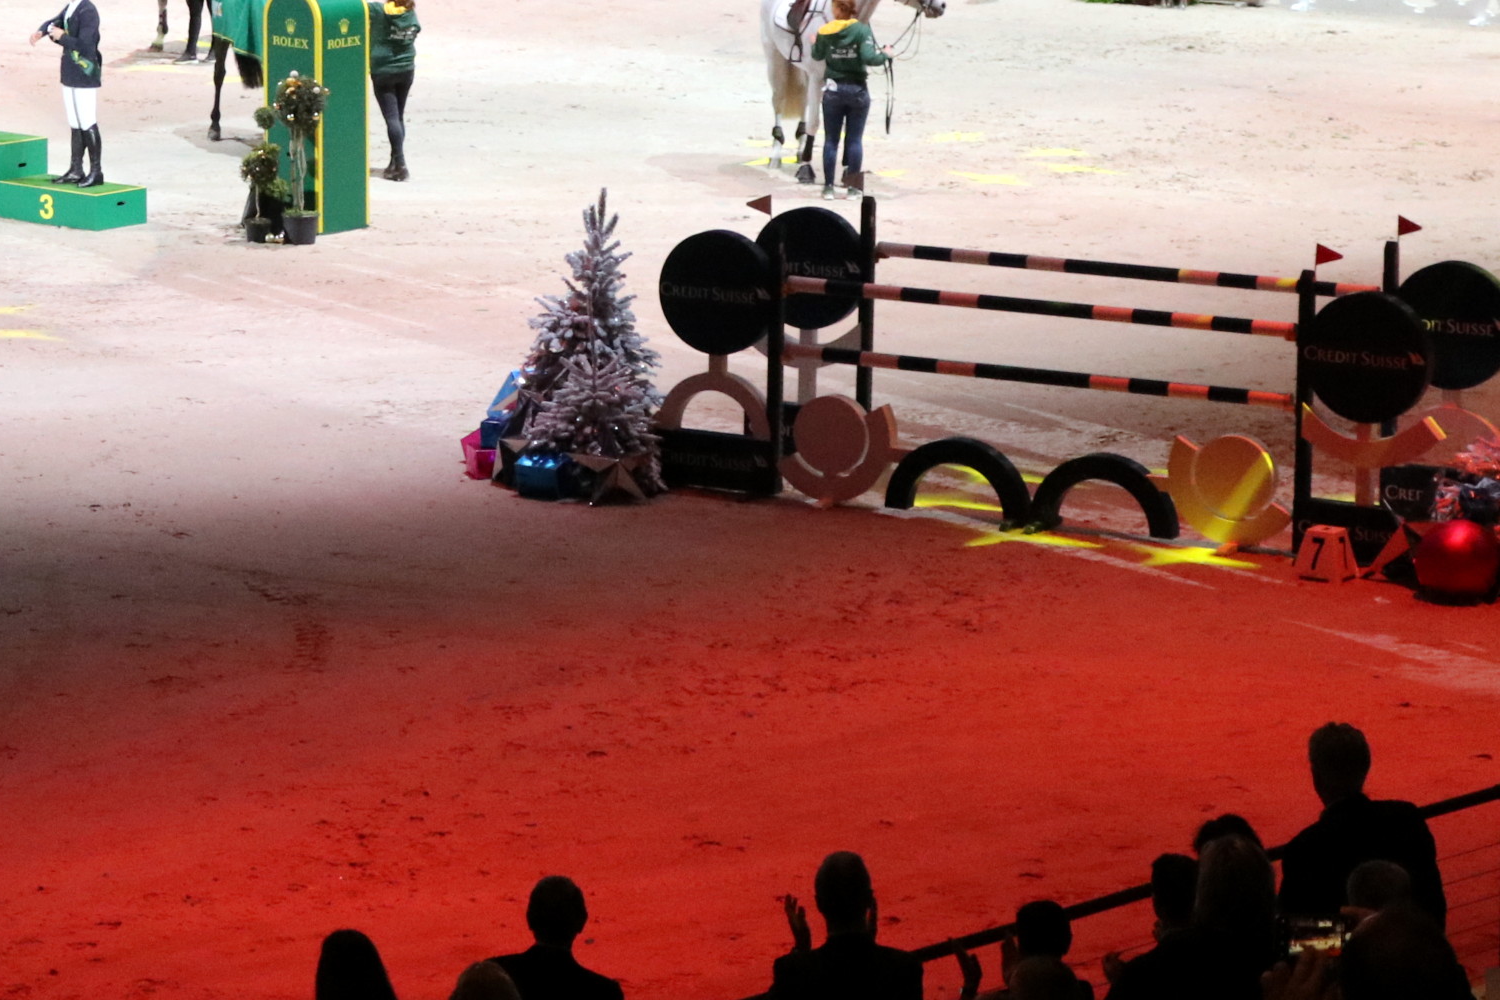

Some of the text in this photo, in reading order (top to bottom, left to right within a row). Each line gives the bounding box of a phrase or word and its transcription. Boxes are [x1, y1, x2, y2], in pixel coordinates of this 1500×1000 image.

[272, 35, 309, 50] ROLEX
[327, 35, 361, 50] ROLEX
[39, 193, 54, 220] 3
[803, 260, 846, 279] SUISSE
[660, 281, 756, 305] CREDIT SUISSE
[1446, 318, 1495, 337] SUISSE
[1303, 344, 1408, 370] CREDIT SUISSE
[1312, 536, 1325, 570] 7
